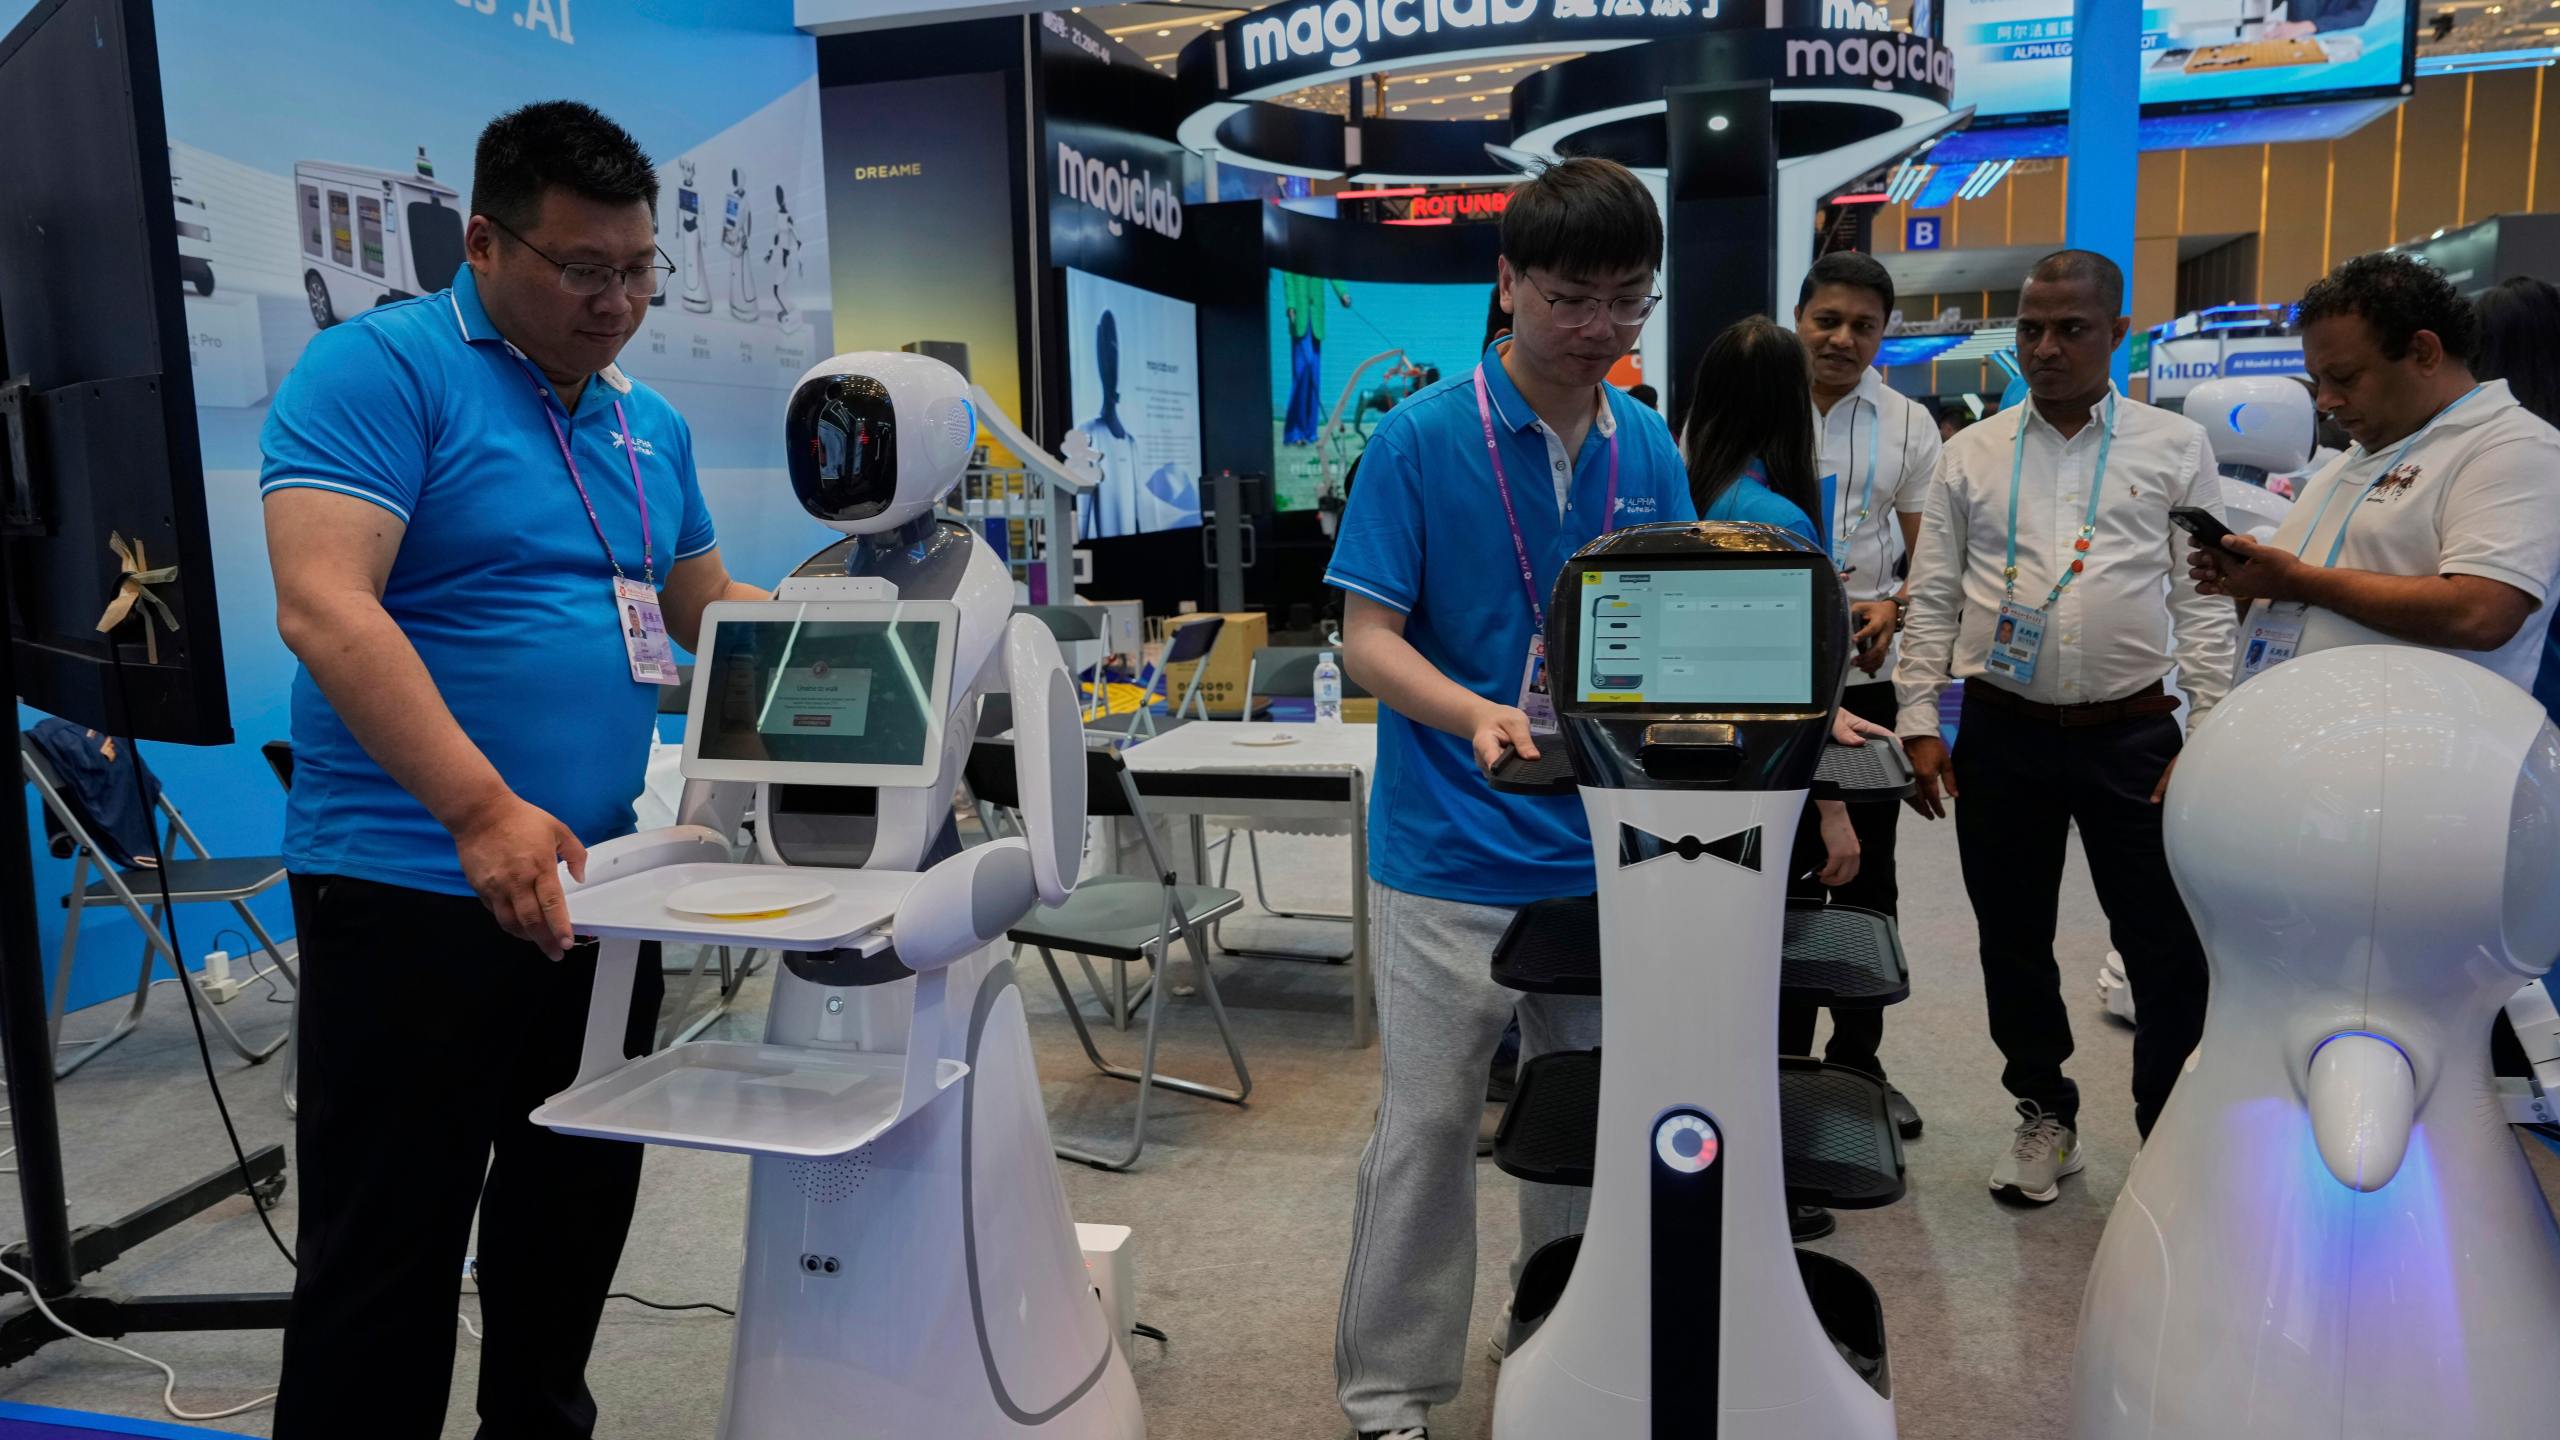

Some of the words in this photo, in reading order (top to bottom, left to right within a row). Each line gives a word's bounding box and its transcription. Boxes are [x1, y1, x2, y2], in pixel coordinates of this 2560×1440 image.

[855, 163, 921, 180] DREAME
[1058, 142, 1182, 240] magiclab
[1915, 222, 1934, 245] B
[1627, 497, 1656, 506] ALPHA
